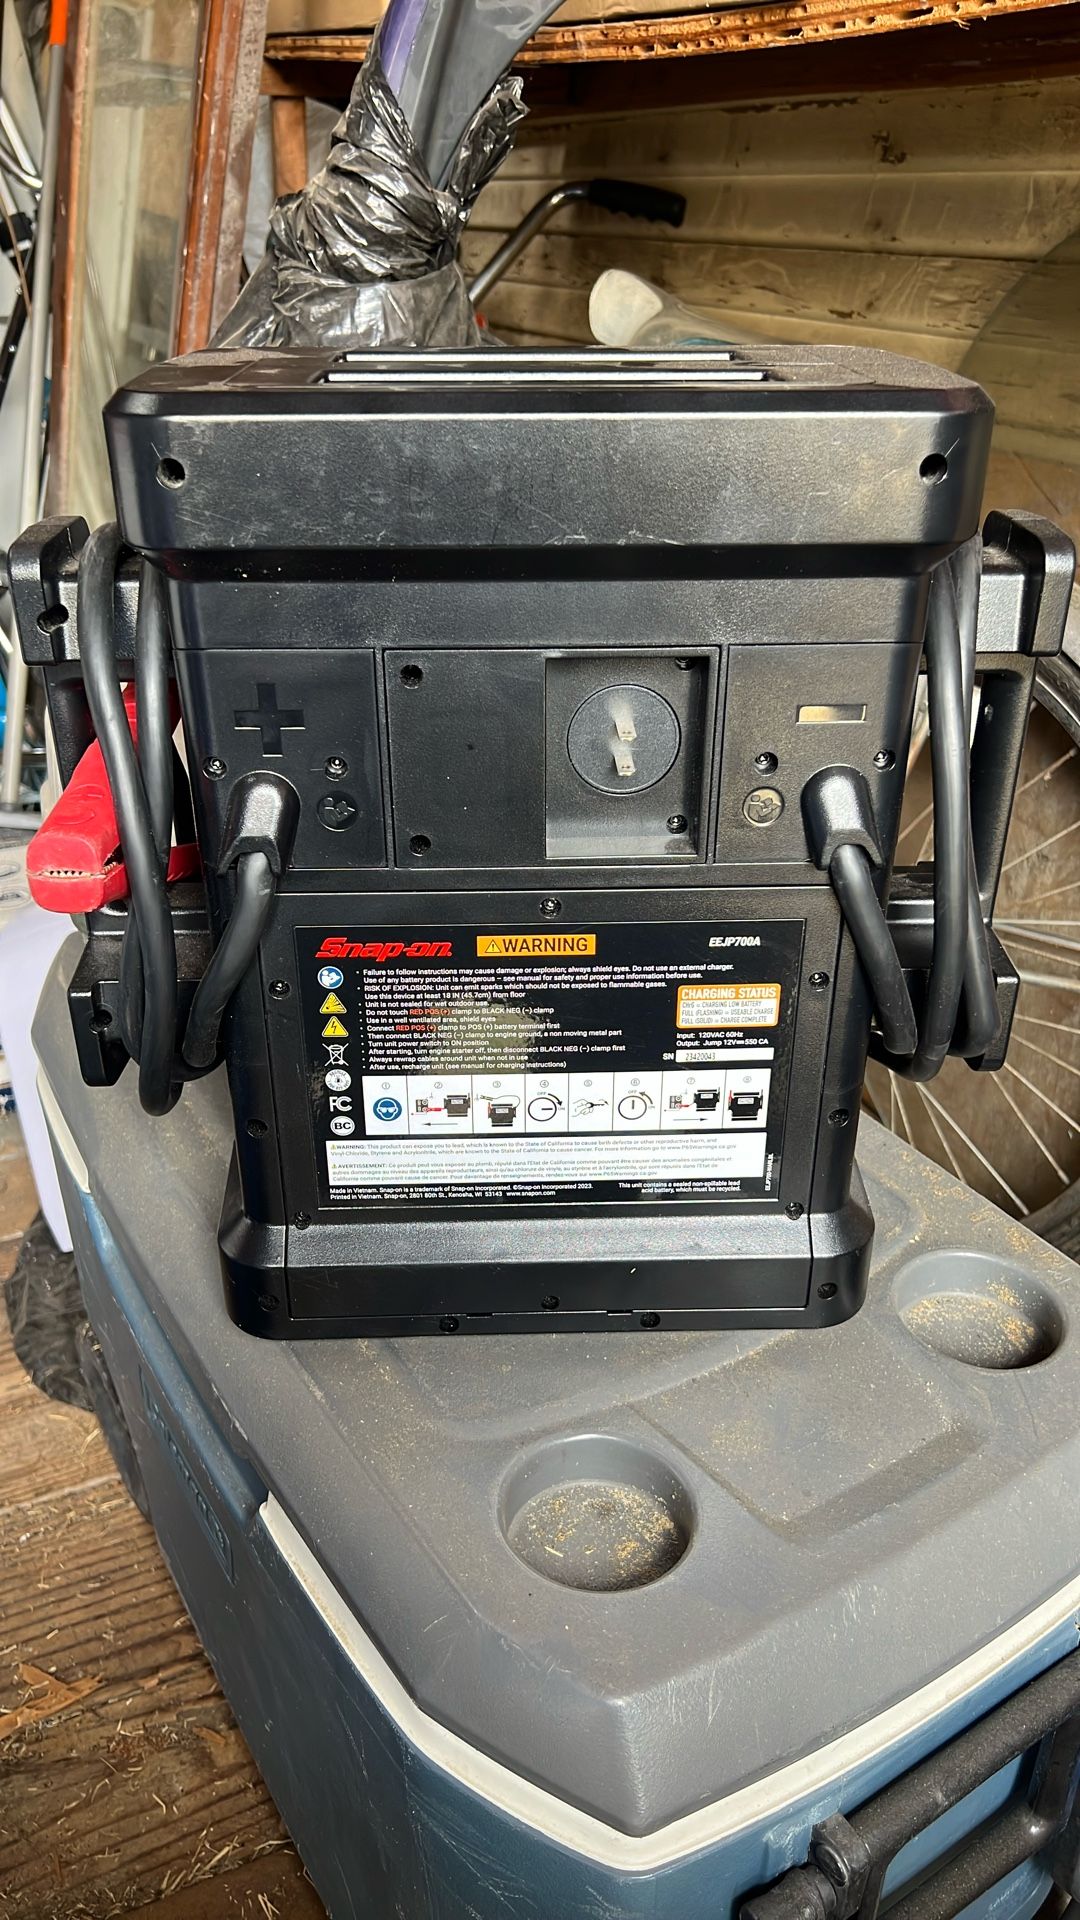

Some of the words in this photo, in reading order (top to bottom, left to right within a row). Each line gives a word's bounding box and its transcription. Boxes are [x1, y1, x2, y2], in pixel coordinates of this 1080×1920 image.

[502, 937, 588, 952] WARNING
[708, 936, 761, 947] EEJP700A
[495, 966, 523, 974] damage
[567, 965, 590, 973] always
[480, 983, 502, 991] sparks
[461, 991, 491, 999] (45.7cm)
[682, 988, 735, 999] CHARGING
[738, 987, 776, 997] STATUS
[334, 1121, 351, 1129] BC
